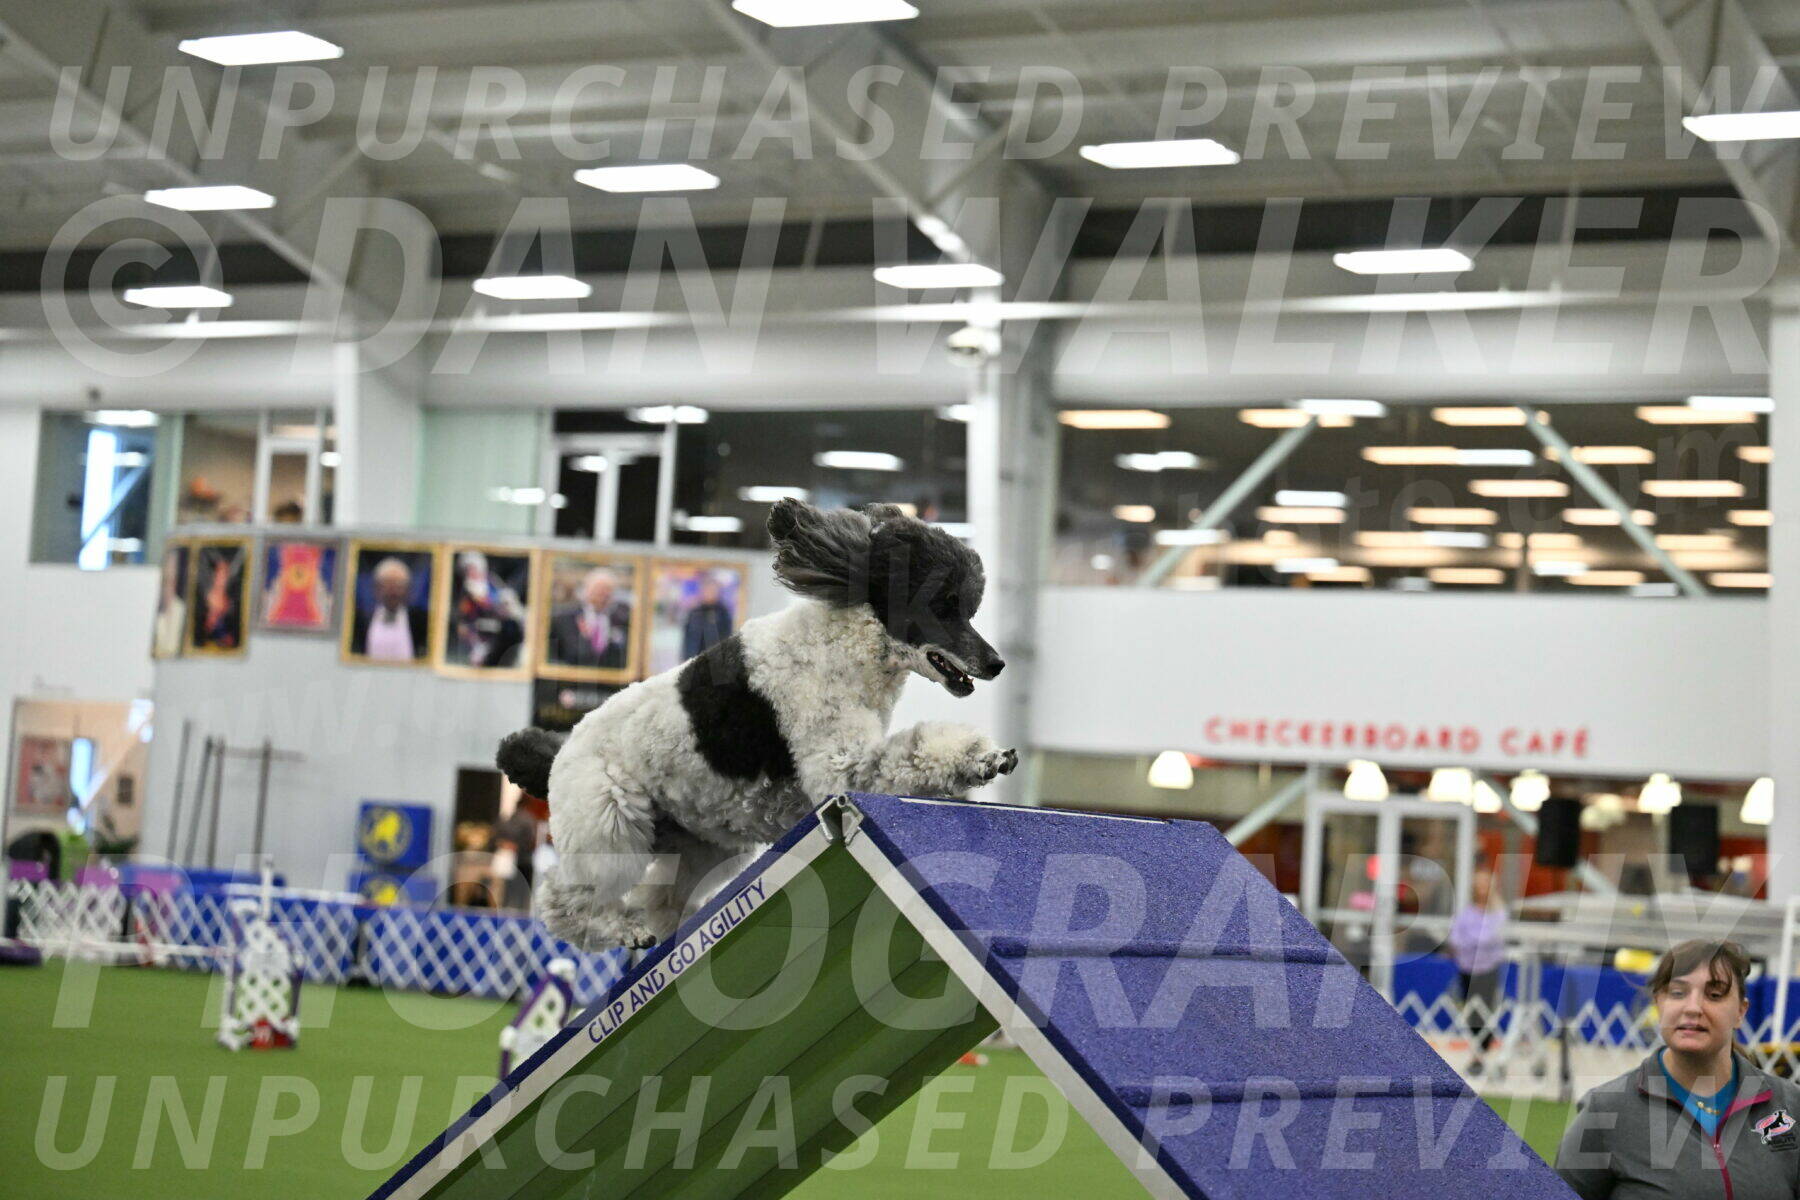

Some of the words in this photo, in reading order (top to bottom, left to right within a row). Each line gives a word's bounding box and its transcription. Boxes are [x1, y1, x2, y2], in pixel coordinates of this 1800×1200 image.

[1204, 715, 1482, 755] CHECKERBOARD
[588, 1001, 625, 1044] CLIP
[630, 969, 666, 1012] AND
[667, 942, 696, 975] GO
[700, 877, 766, 952] AGILITY
